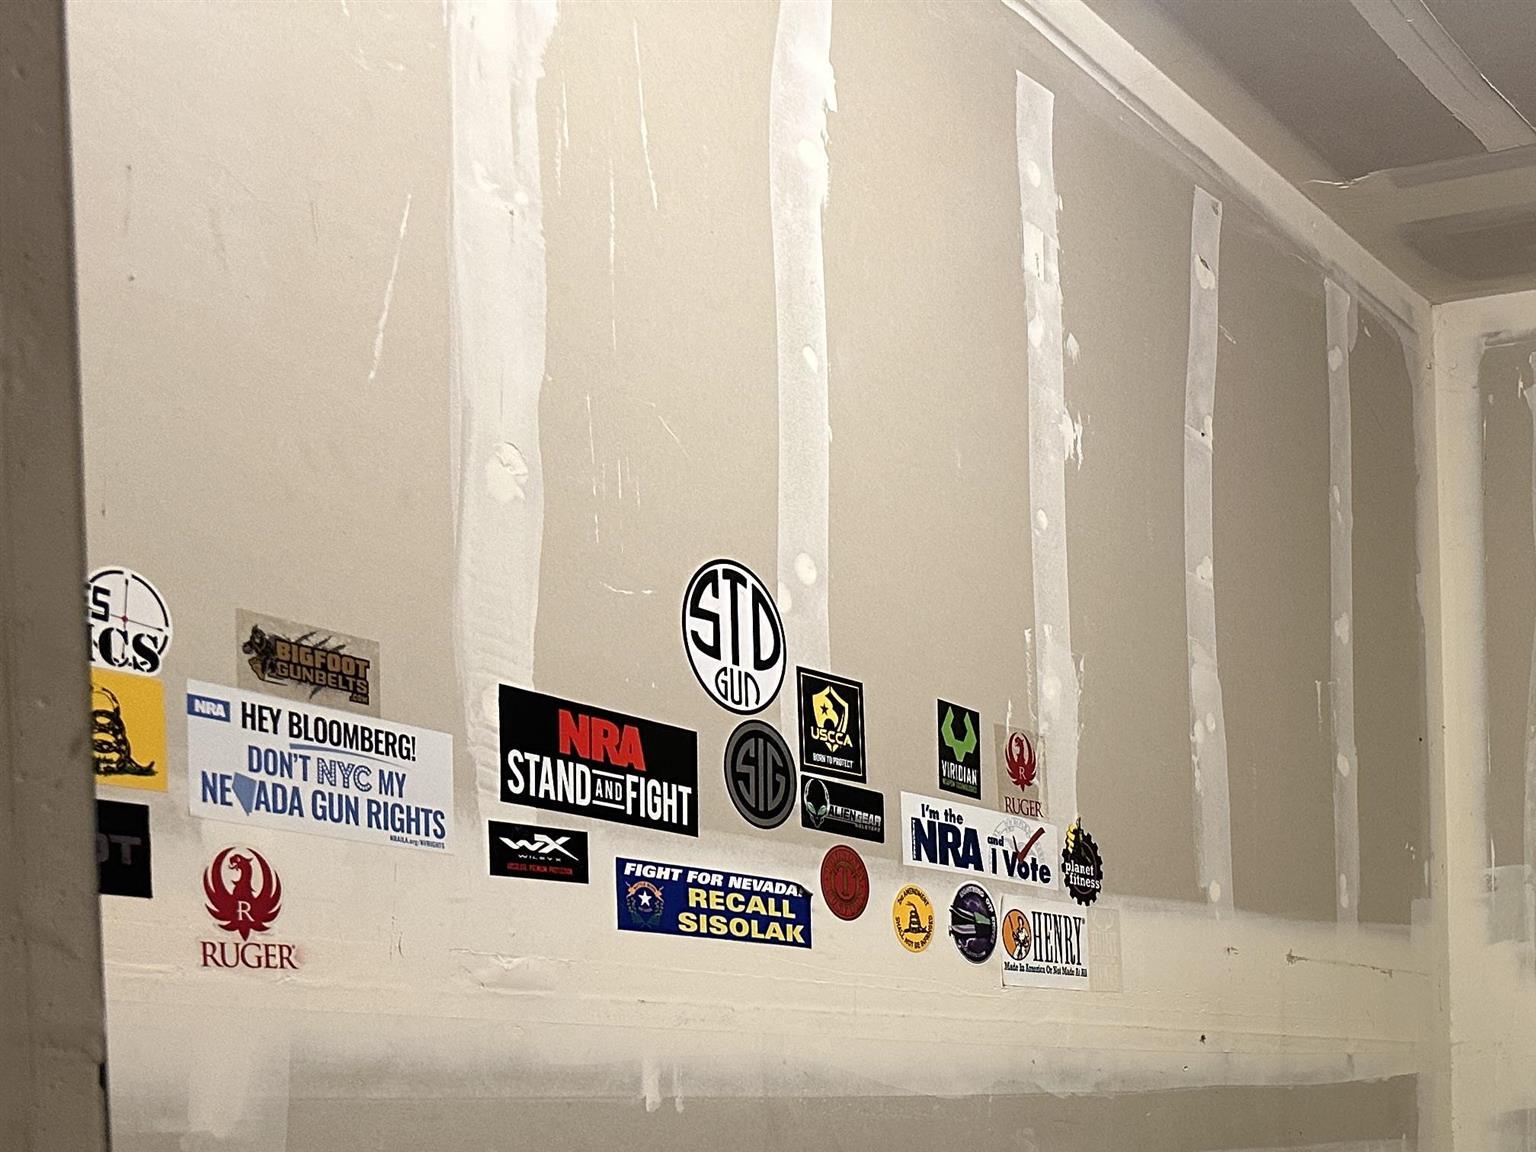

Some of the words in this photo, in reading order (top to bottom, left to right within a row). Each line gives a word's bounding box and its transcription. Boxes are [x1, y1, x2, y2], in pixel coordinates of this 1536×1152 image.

[689, 567, 781, 671] STD
[275, 640, 370, 679] BIGFOOT
[276, 660, 369, 695] GUNBELTS
[714, 666, 760, 707] GUN
[194, 699, 226, 718] NRA
[241, 701, 282, 735] HEY
[288, 710, 416, 762] BLOOMBERG!
[558, 709, 647, 772] NRA
[811, 726, 853, 748] USCCA
[248, 745, 311, 782] DON'T
[317, 757, 373, 792] NYC
[378, 769, 407, 798] MY
[507, 749, 592, 806] STAND
[595, 778, 623, 801] AND
[626, 774, 692, 826] FIGHT
[736, 738, 786, 812] SIG
[941, 760, 978, 785] VIRIDIAN
[1019, 766, 1027, 779] R
[311, 789, 360, 826] GUN
[366, 798, 446, 840] RIGHTS
[921, 803, 940, 821] I'm
[944, 808, 964, 825] the
[1004, 796, 1043, 818] RUGER
[910, 817, 985, 872] NRA
[987, 835, 1005, 847] and
[624, 863, 683, 881] FIGHT
[687, 870, 723, 887] FOR
[991, 848, 998, 875] I
[1002, 848, 1051, 884] Vote
[1065, 860, 1094, 876] planet
[1069, 872, 1101, 889] fitness
[237, 900, 255, 922] R
[688, 887, 796, 919] RECALL
[677, 911, 805, 944] SISOLAK
[1031, 911, 1082, 966] HENRY
[200, 941, 299, 969] RUGER
[1004, 961, 1019, 972] Made
